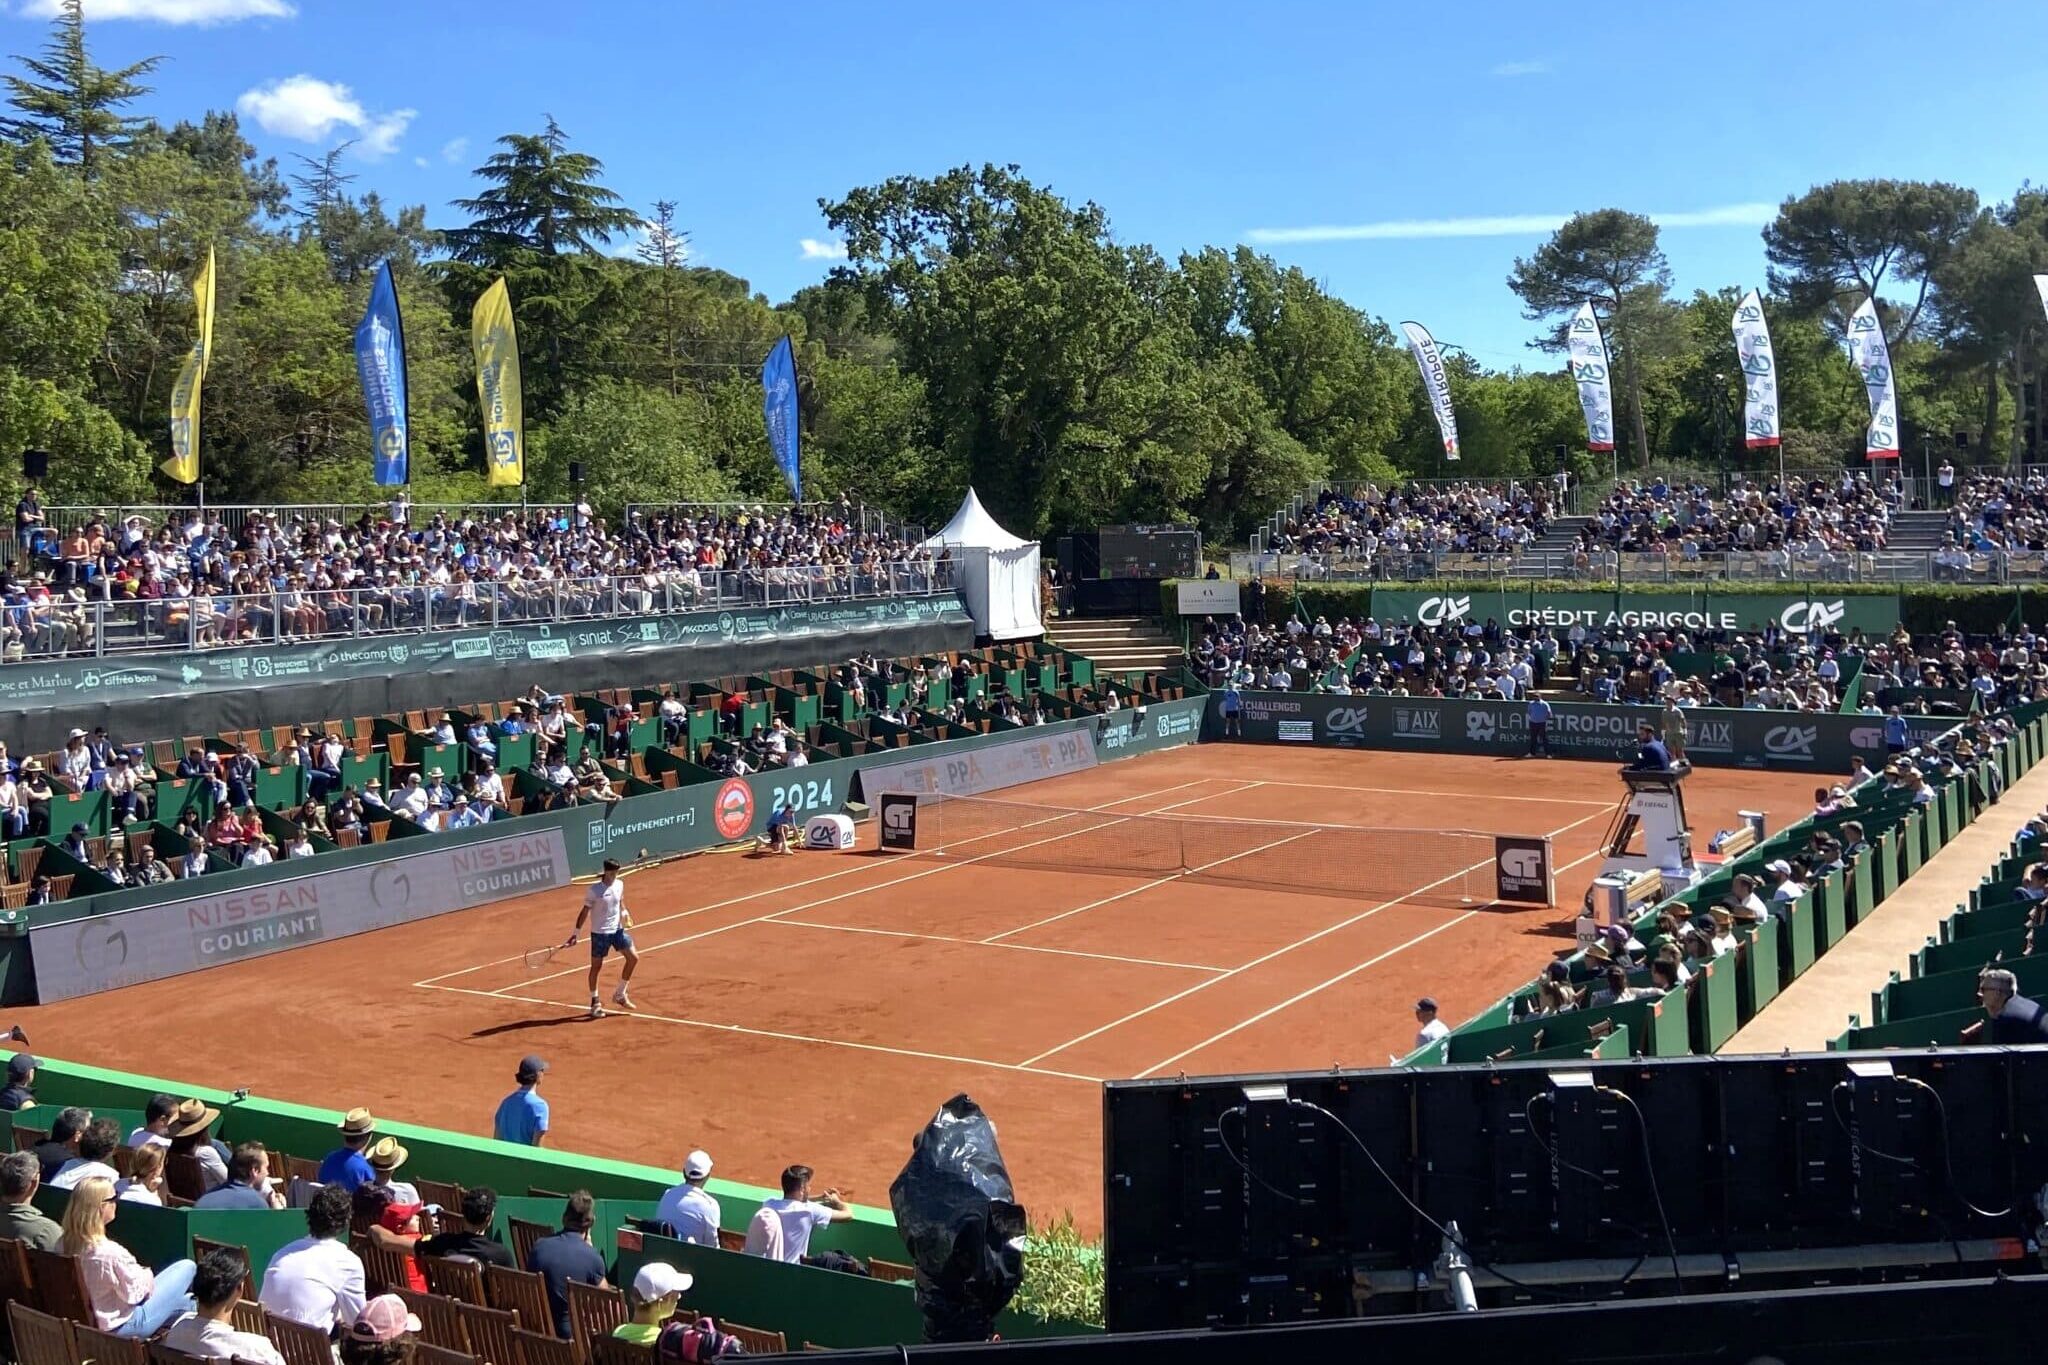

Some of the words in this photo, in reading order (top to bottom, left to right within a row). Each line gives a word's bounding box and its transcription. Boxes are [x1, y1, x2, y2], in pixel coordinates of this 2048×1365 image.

[1508, 606, 1598, 627] CRÉDIT
[1604, 609, 1737, 630] AGRICOLE
[531, 641, 566, 650] OLYMPIC
[579, 630, 614, 646] siniat
[340, 649, 388, 662] thecamp
[18, 681, 29, 690] et
[31, 673, 73, 690] Marius
[135, 674, 158, 684] bona
[1245, 701, 1301, 712] CHALLENGER
[1245, 710, 1269, 720] TOUR
[1412, 710, 1439, 729] AIX
[1500, 711, 1524, 729] LA
[1700, 721, 1731, 743] AIX
[1059, 733, 1089, 762] PPA
[1107, 738, 1119, 748] SUD
[947, 753, 983, 785] PPA
[773, 778, 833, 814] 2024
[591, 824, 603, 835] TEN
[591, 839, 603, 849] NIS
[453, 837, 551, 876] NISSAN
[463, 865, 551, 896] COURIANT
[1501, 876, 1543, 887] CHALLENGER
[1502, 884, 1519, 892] TOUR
[187, 883, 318, 930] NISSAN
[200, 915, 318, 954] COURIANT
